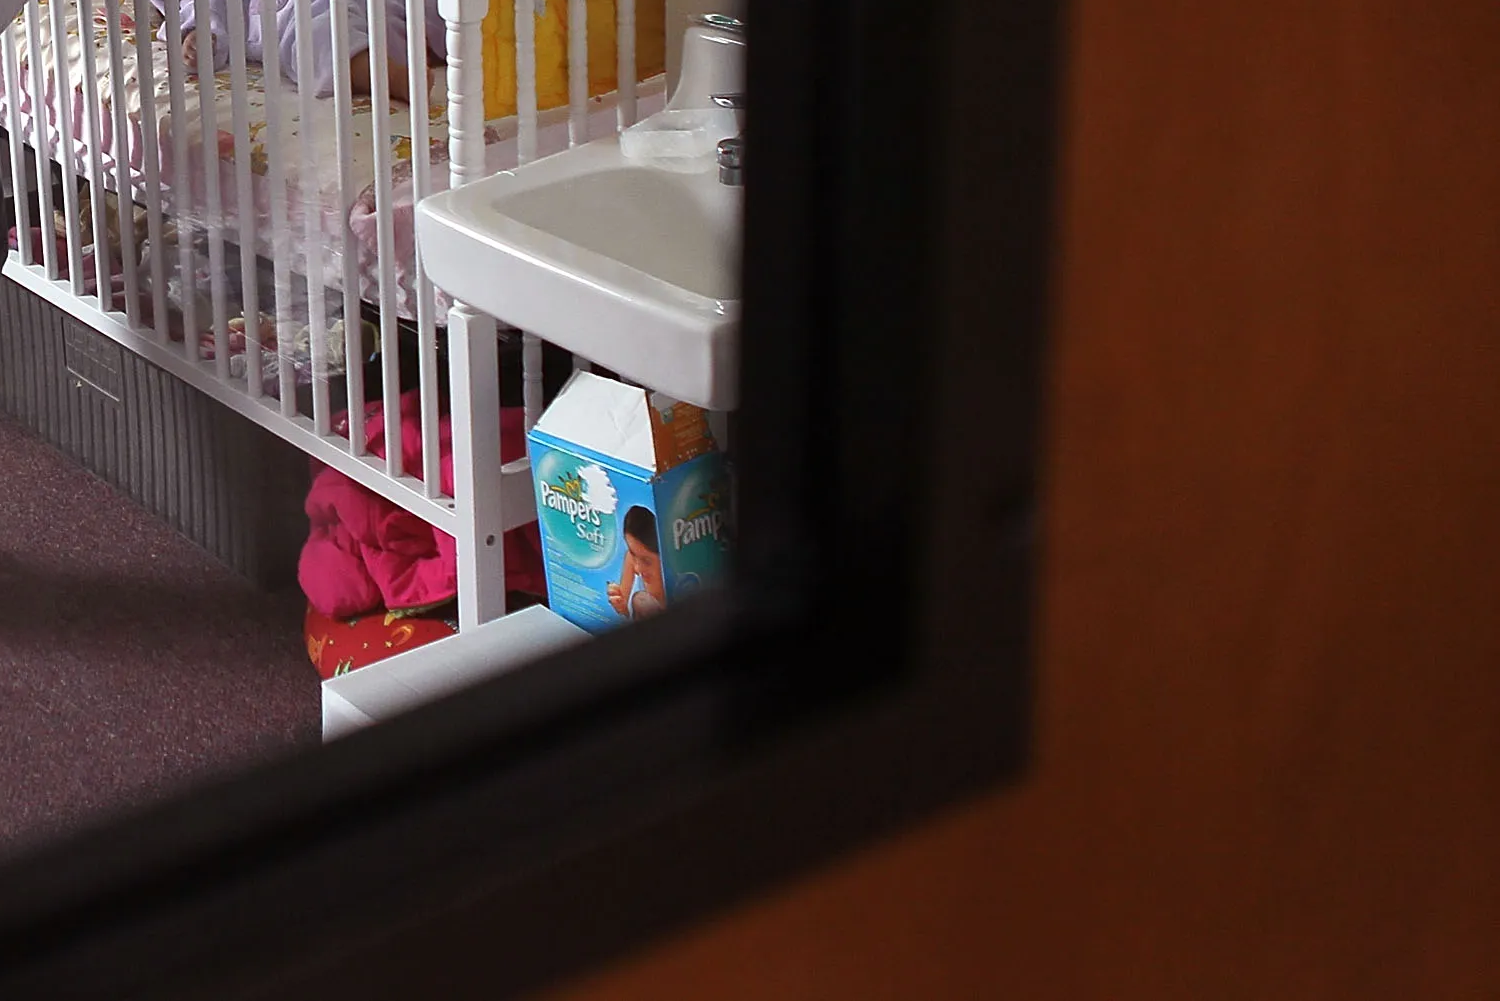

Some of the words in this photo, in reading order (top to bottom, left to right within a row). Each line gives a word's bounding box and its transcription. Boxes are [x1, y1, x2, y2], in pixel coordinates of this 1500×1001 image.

[540, 480, 601, 526] Pampers
[576, 522, 605, 545] Soft
[672, 511, 723, 550] Pamp
